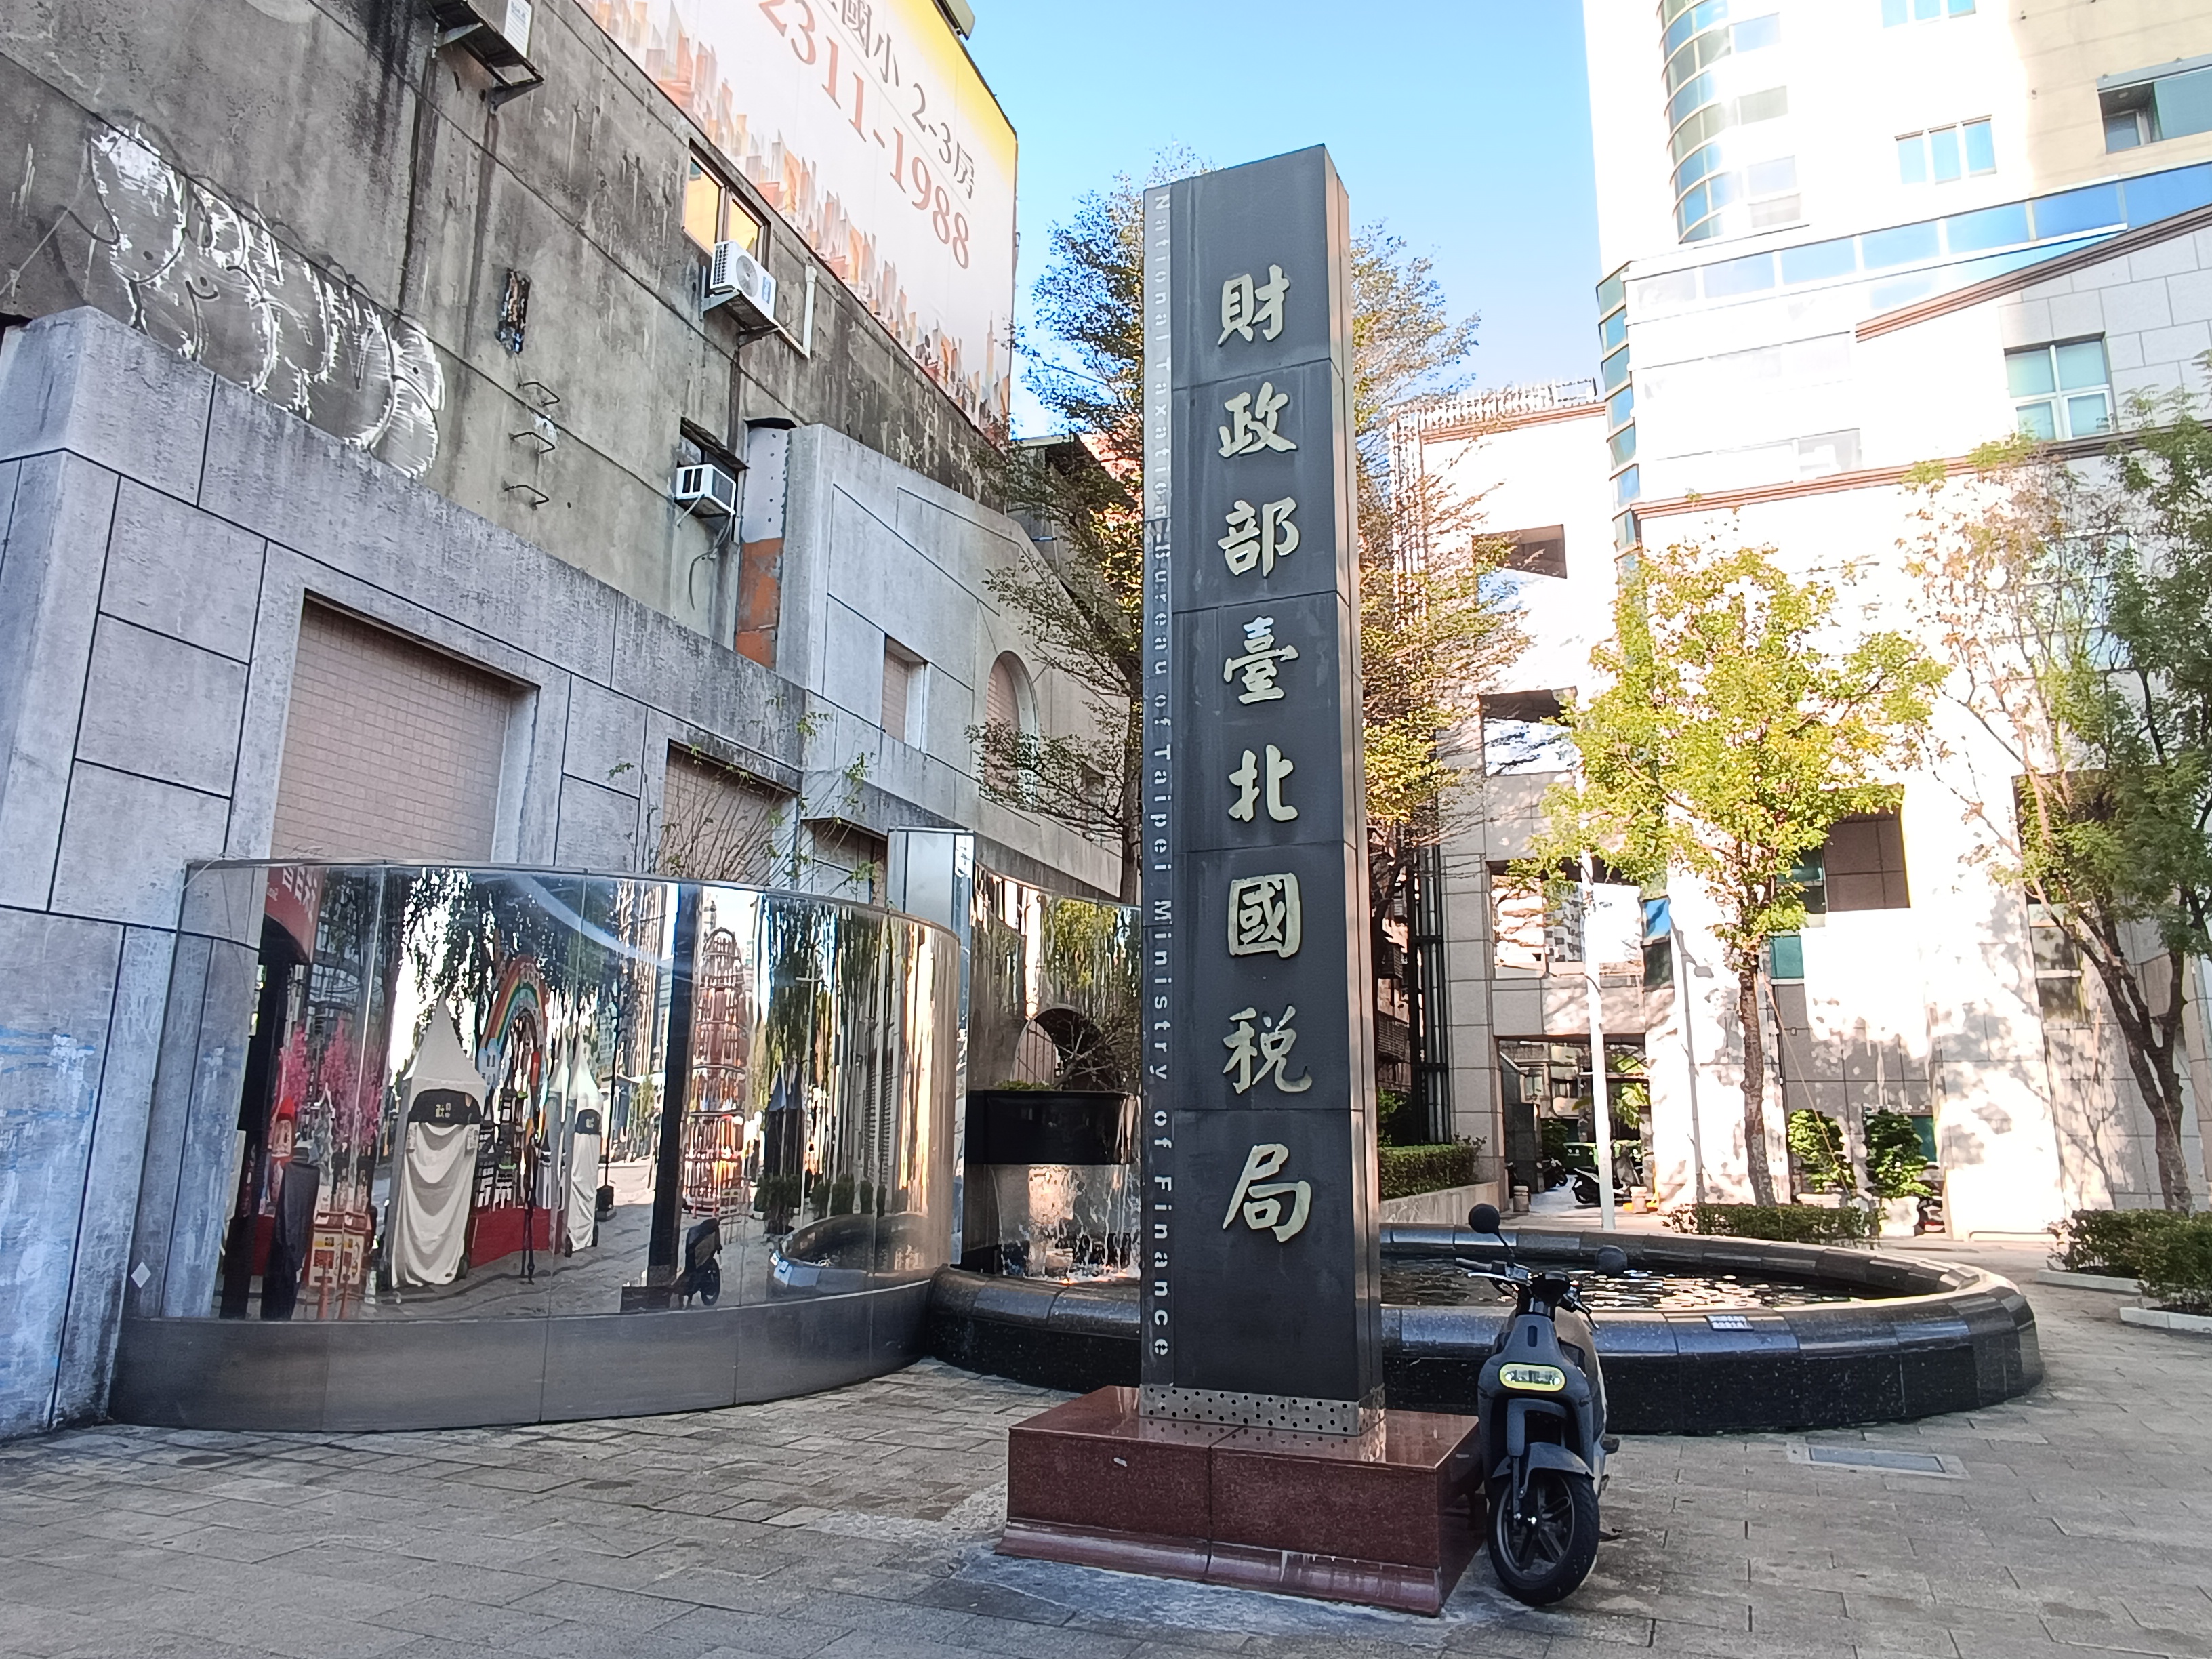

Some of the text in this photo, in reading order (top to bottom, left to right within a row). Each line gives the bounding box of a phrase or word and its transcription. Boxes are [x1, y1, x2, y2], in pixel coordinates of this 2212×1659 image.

[827, 0, 975, 199] 國小 2-3房
[1150, 194, 1172, 1356] National Taxation Bureau of Taipei Ministry of Finance
